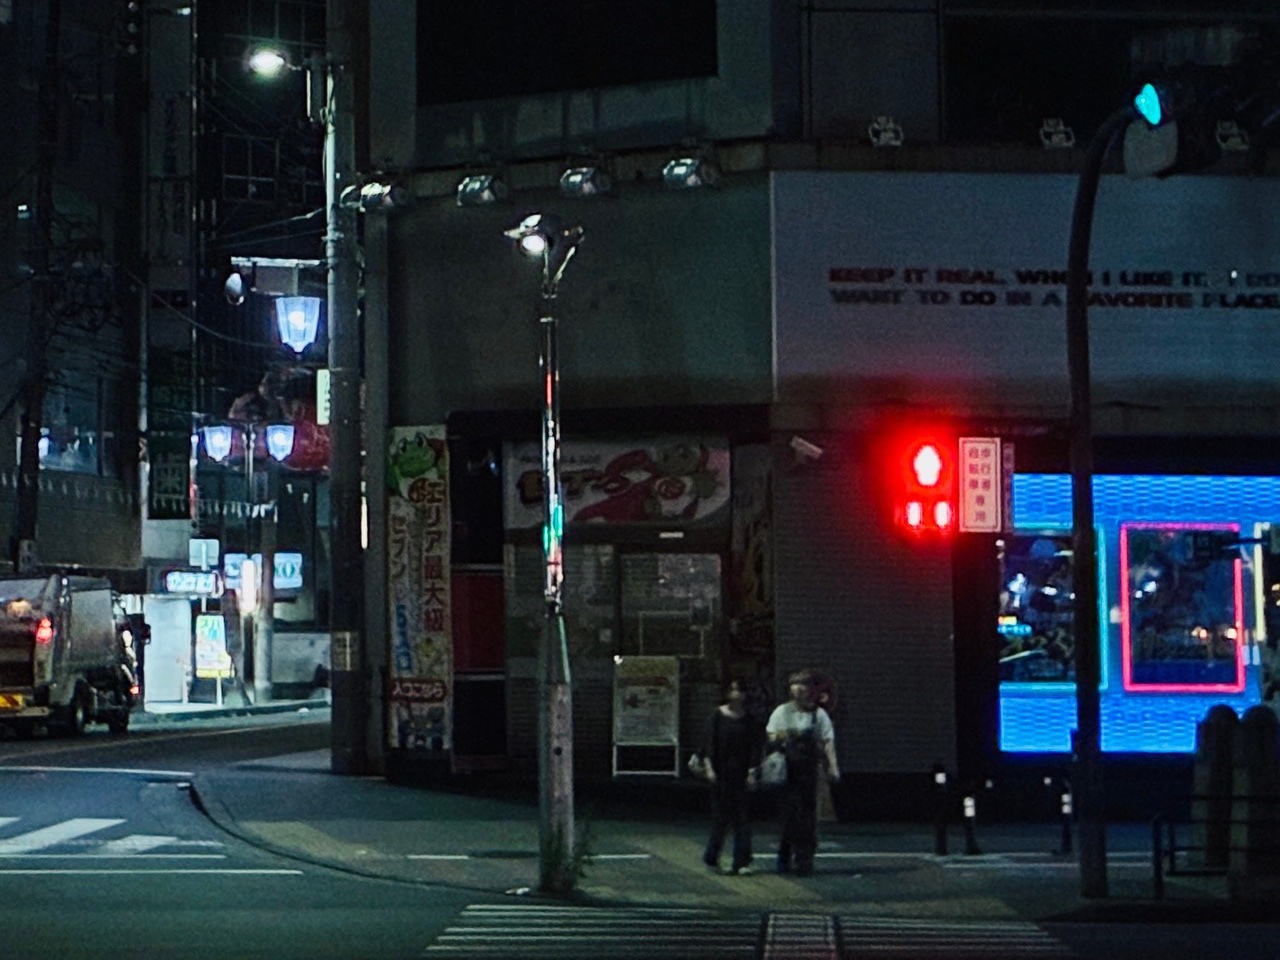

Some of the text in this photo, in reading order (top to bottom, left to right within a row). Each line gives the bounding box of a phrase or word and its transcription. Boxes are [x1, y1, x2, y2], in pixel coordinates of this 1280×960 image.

[830, 267, 896, 283] KEEP
[904, 267, 928, 284] IT
[1121, 270, 1173, 286] LIKE
[917, 291, 950, 306] TO
[961, 291, 997, 306] DO
[1087, 293, 1194, 308] AVORITE
